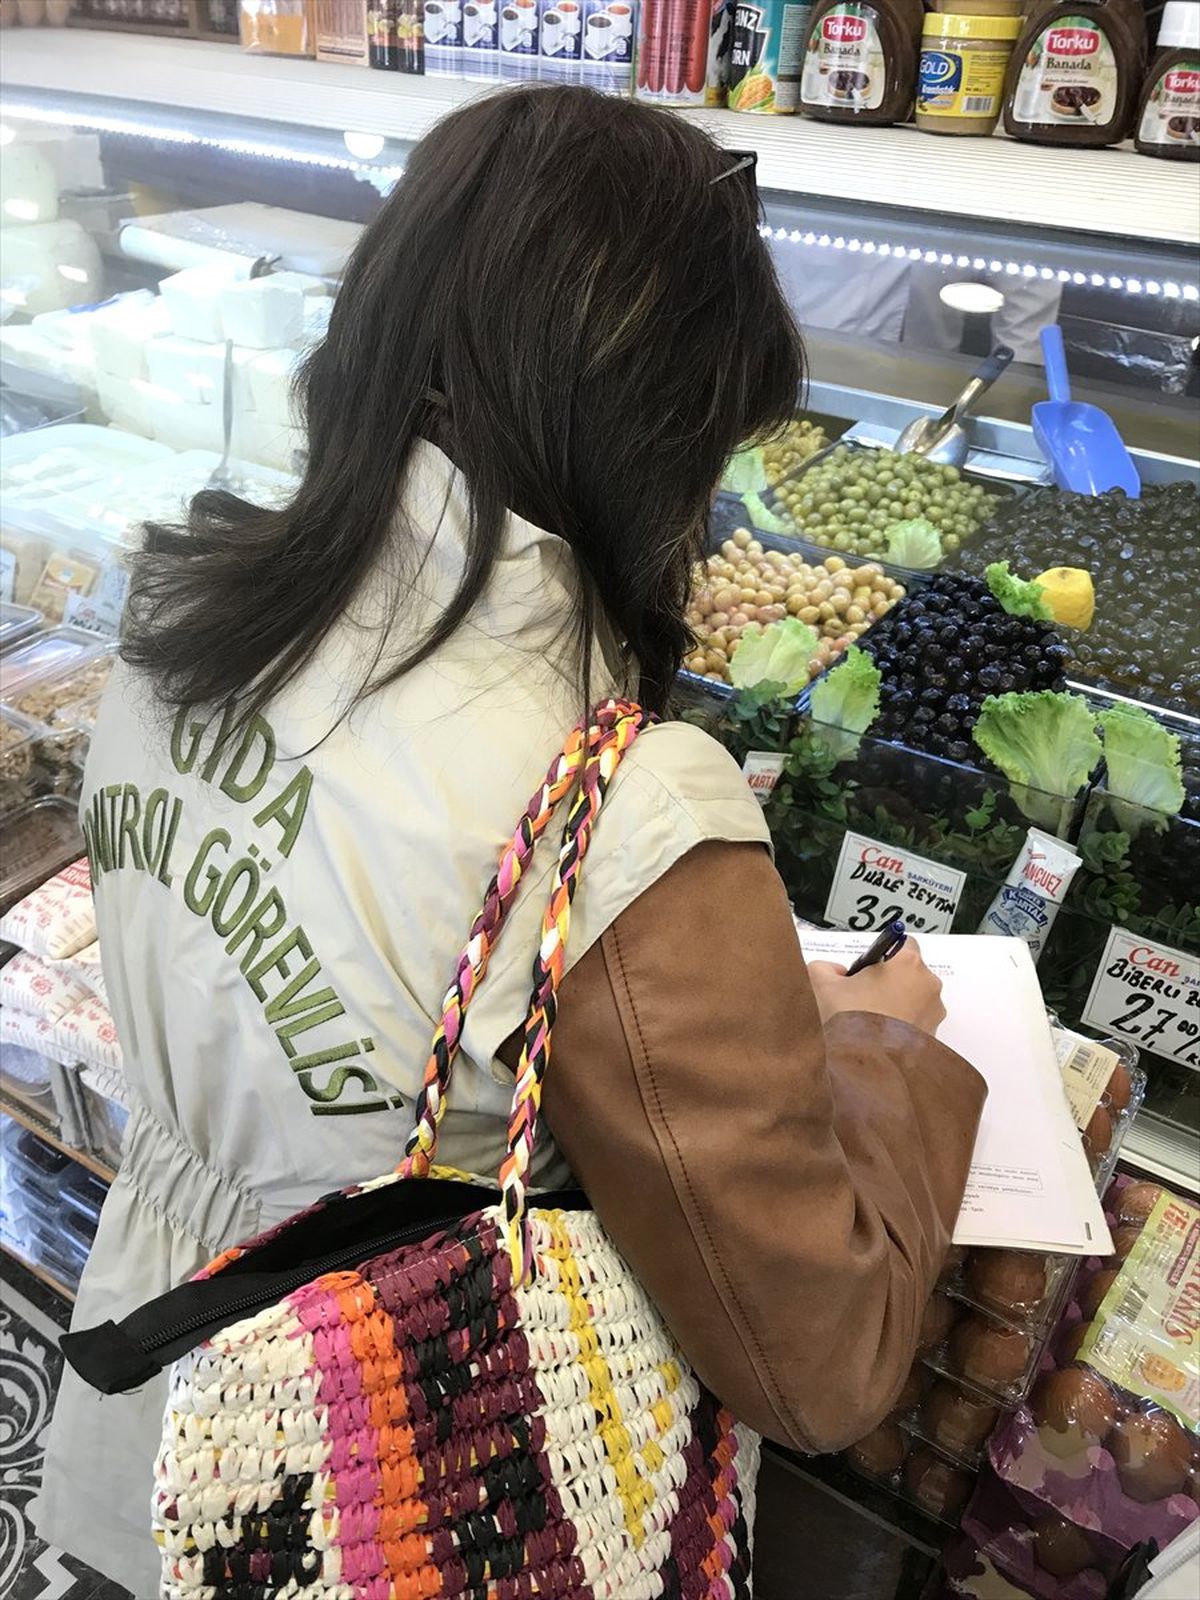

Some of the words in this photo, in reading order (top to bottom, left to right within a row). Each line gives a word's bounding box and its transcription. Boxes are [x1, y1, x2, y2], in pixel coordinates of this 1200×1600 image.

[826, 21, 862, 36] Torku
[1051, 34, 1094, 49] Torku
[823, 43, 861, 57] Banada
[1046, 57, 1091, 70] Banada
[171, 699, 314, 858] GIDA
[861, 847, 904, 873] Can
[1023, 861, 1063, 898] ANÇUEZ
[184, 827, 404, 1116] GÖREVLİSİ
[1129, 947, 1180, 977] Can
